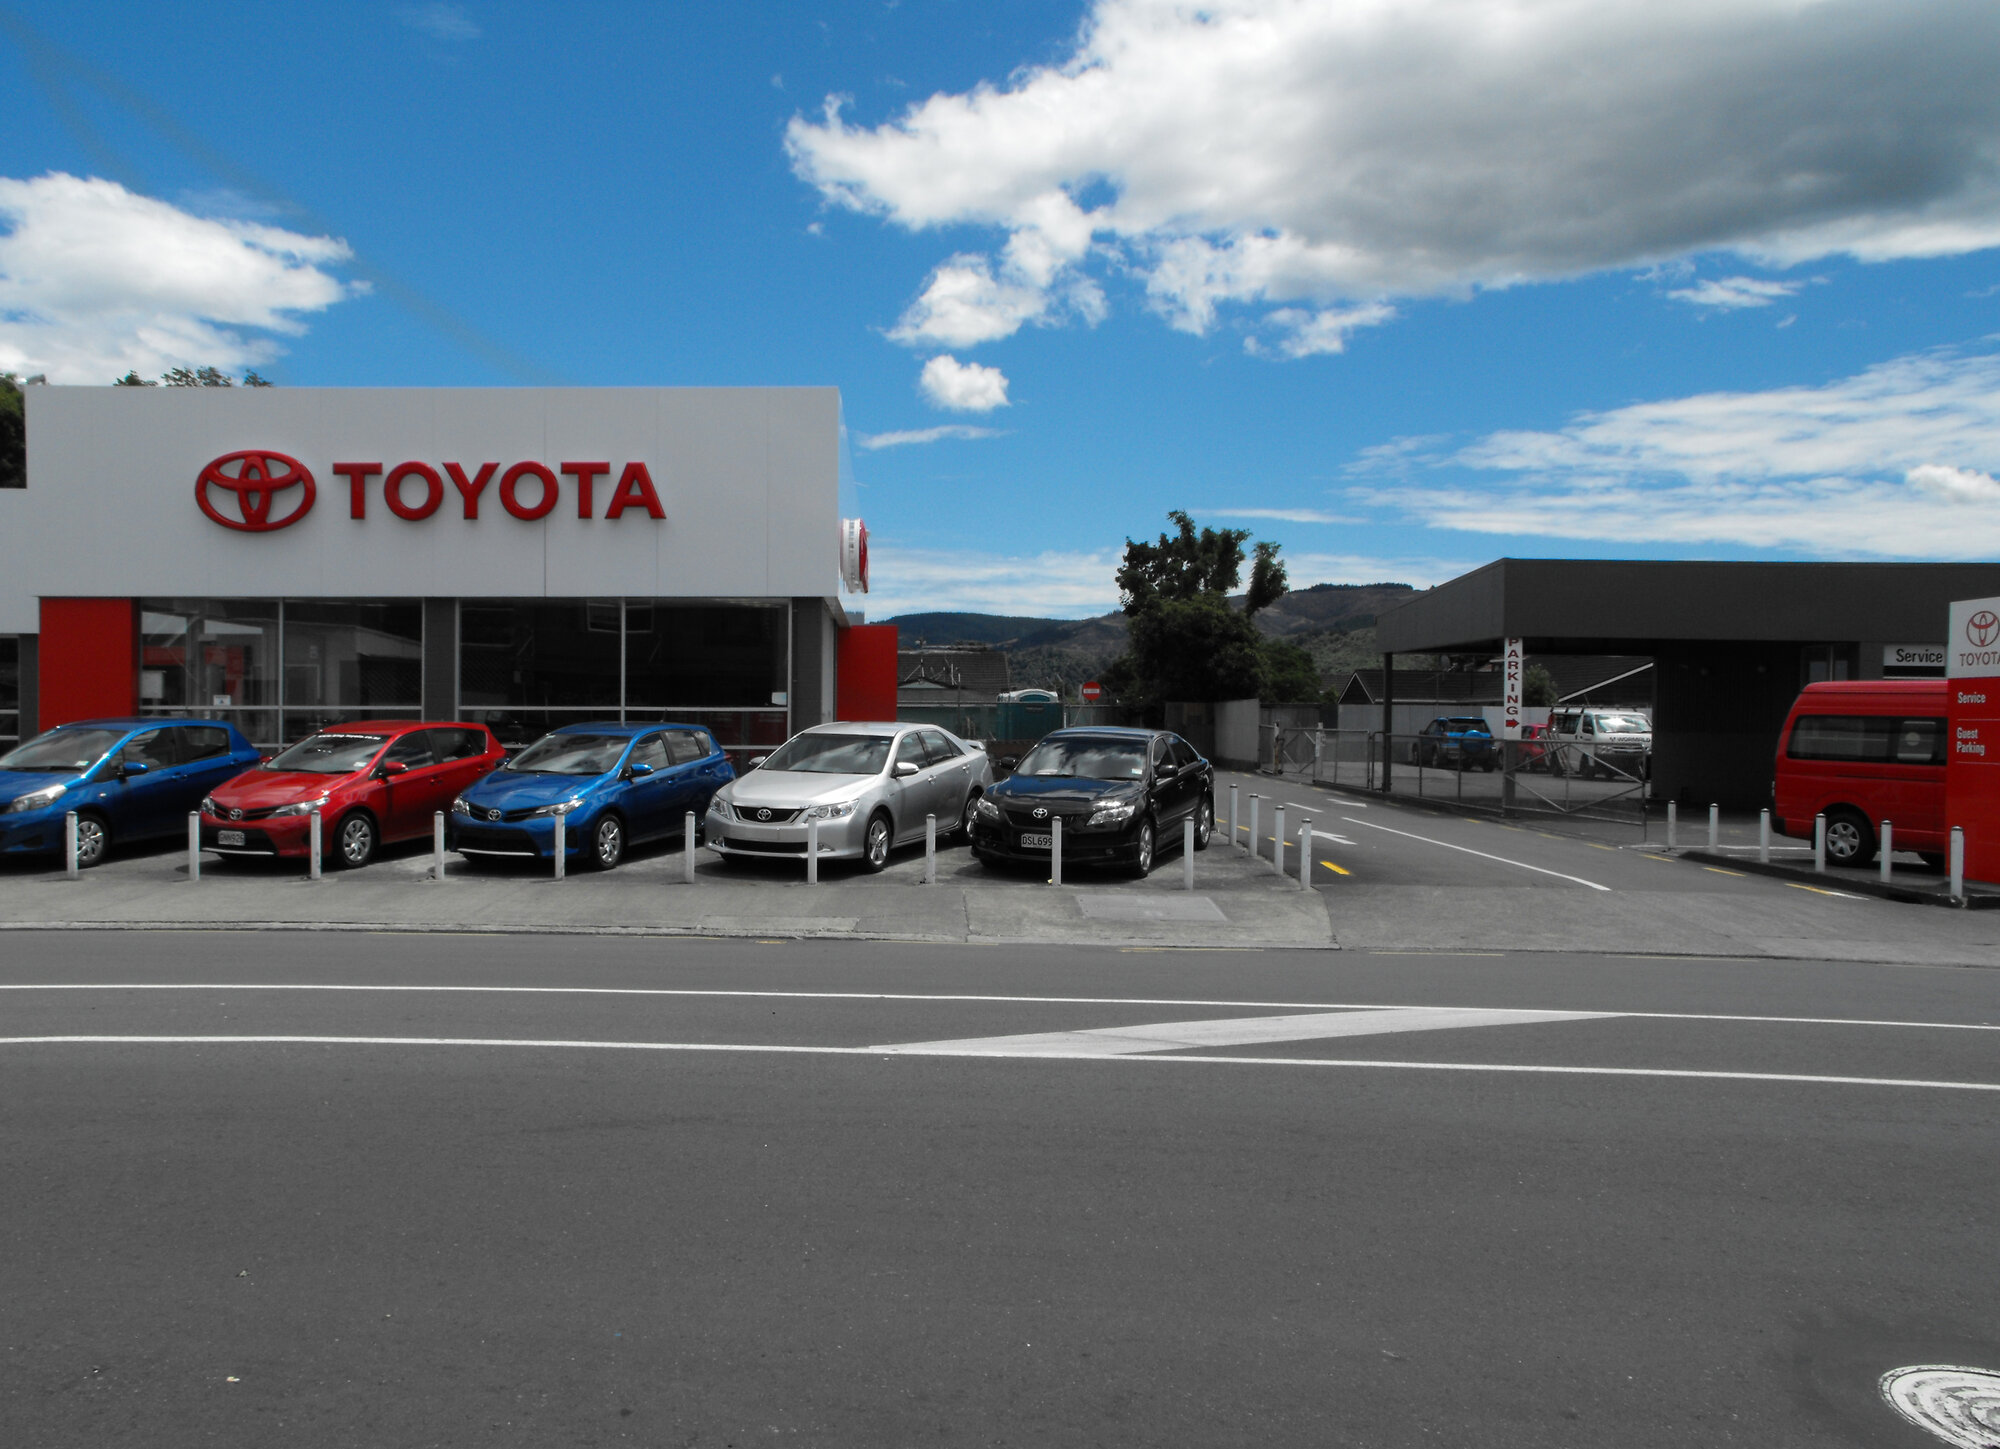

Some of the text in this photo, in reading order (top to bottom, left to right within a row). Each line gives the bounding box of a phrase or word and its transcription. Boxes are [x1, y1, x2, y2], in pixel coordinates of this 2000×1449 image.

[333, 460, 667, 521] TOYOTA
[1896, 648, 1943, 663] Service
[1506, 638, 1519, 715] PARKING
[1958, 692, 1985, 703] Service
[1957, 727, 1978, 739] Guest
[1957, 742, 1985, 756] Parking
[1022, 835, 1052, 847] DSL699
